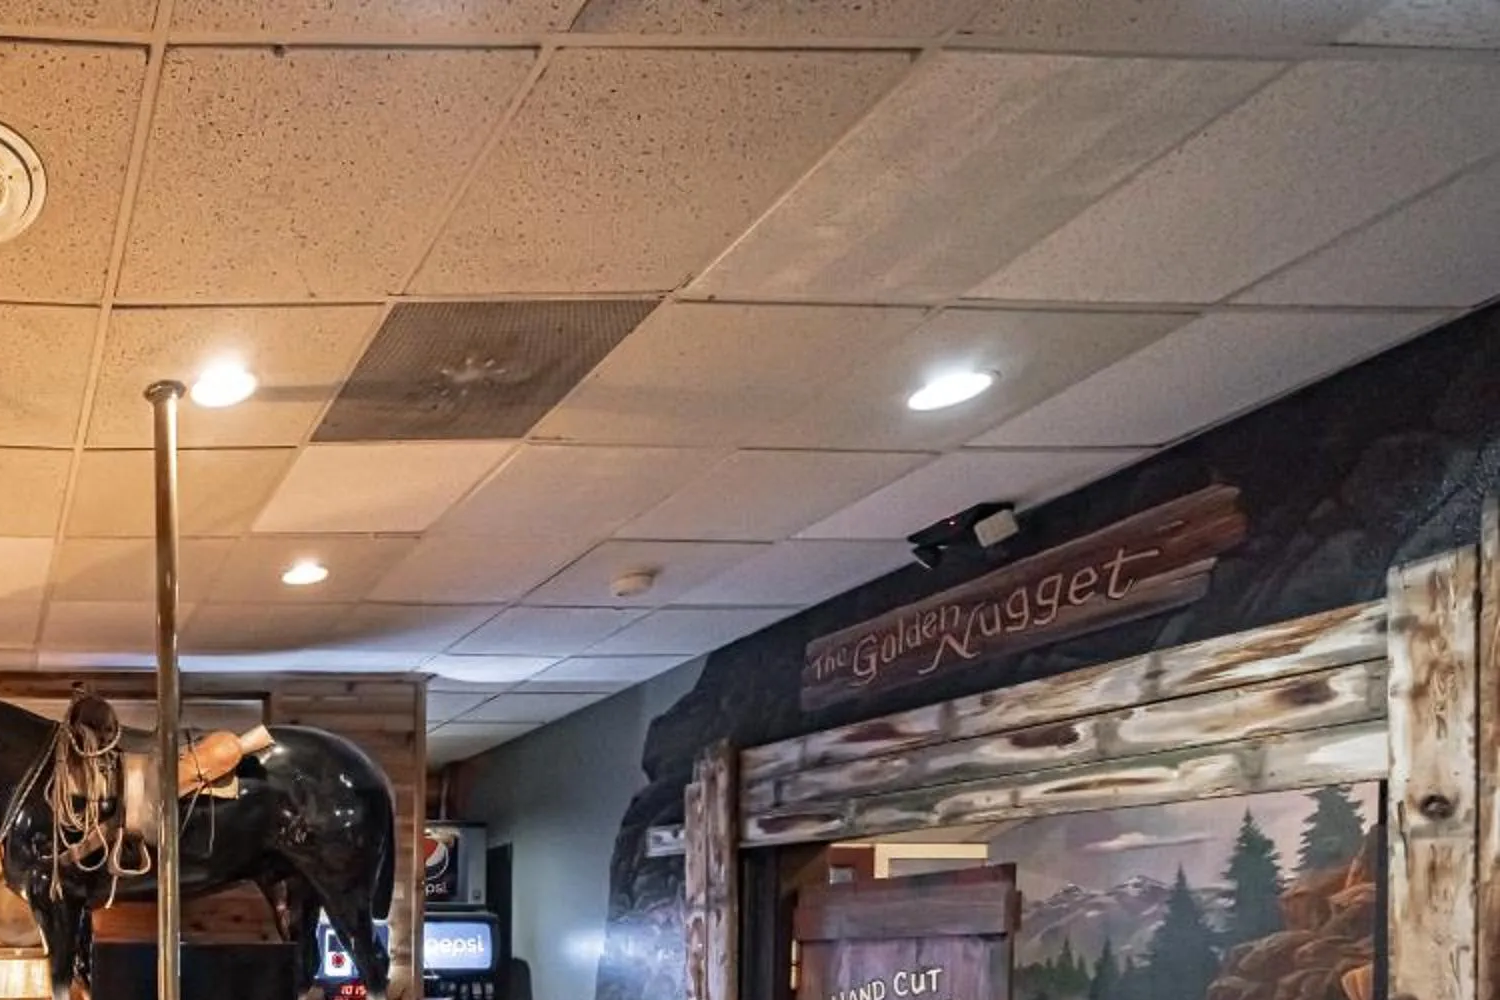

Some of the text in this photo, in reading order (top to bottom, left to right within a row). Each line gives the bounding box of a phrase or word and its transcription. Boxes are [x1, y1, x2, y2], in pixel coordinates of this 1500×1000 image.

[811, 547, 1160, 687] The Golden Nugget
[893, 968, 943, 997] CUT
